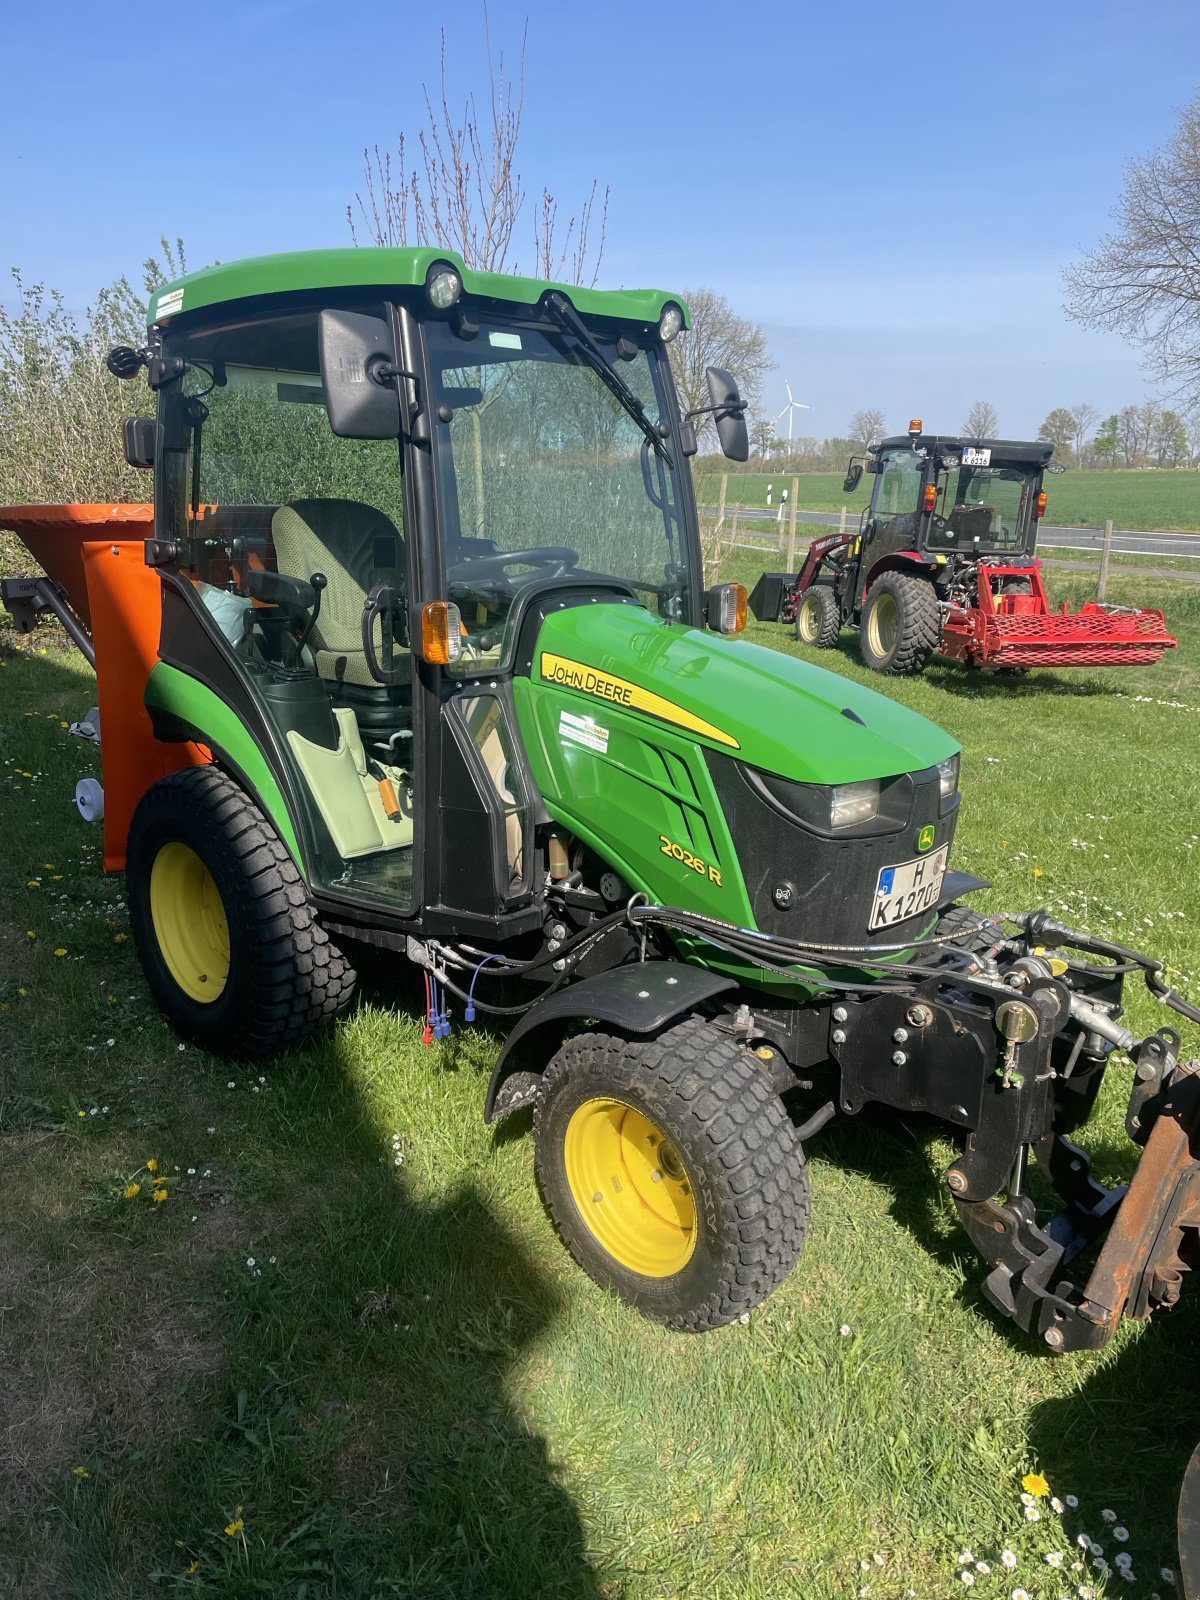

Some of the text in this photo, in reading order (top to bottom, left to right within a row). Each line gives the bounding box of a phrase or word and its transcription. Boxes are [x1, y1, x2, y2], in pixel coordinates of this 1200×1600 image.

[971, 457, 988, 465] 6116
[549, 662, 632, 704] JOHN DEERE
[659, 835, 723, 888] 2026 R
[912, 860, 926, 888] H
[875, 899, 891, 926] K
[892, 882, 934, 922] 1270
[882, 885, 888, 893] D
[653, 1102, 718, 1234] GALAXY
